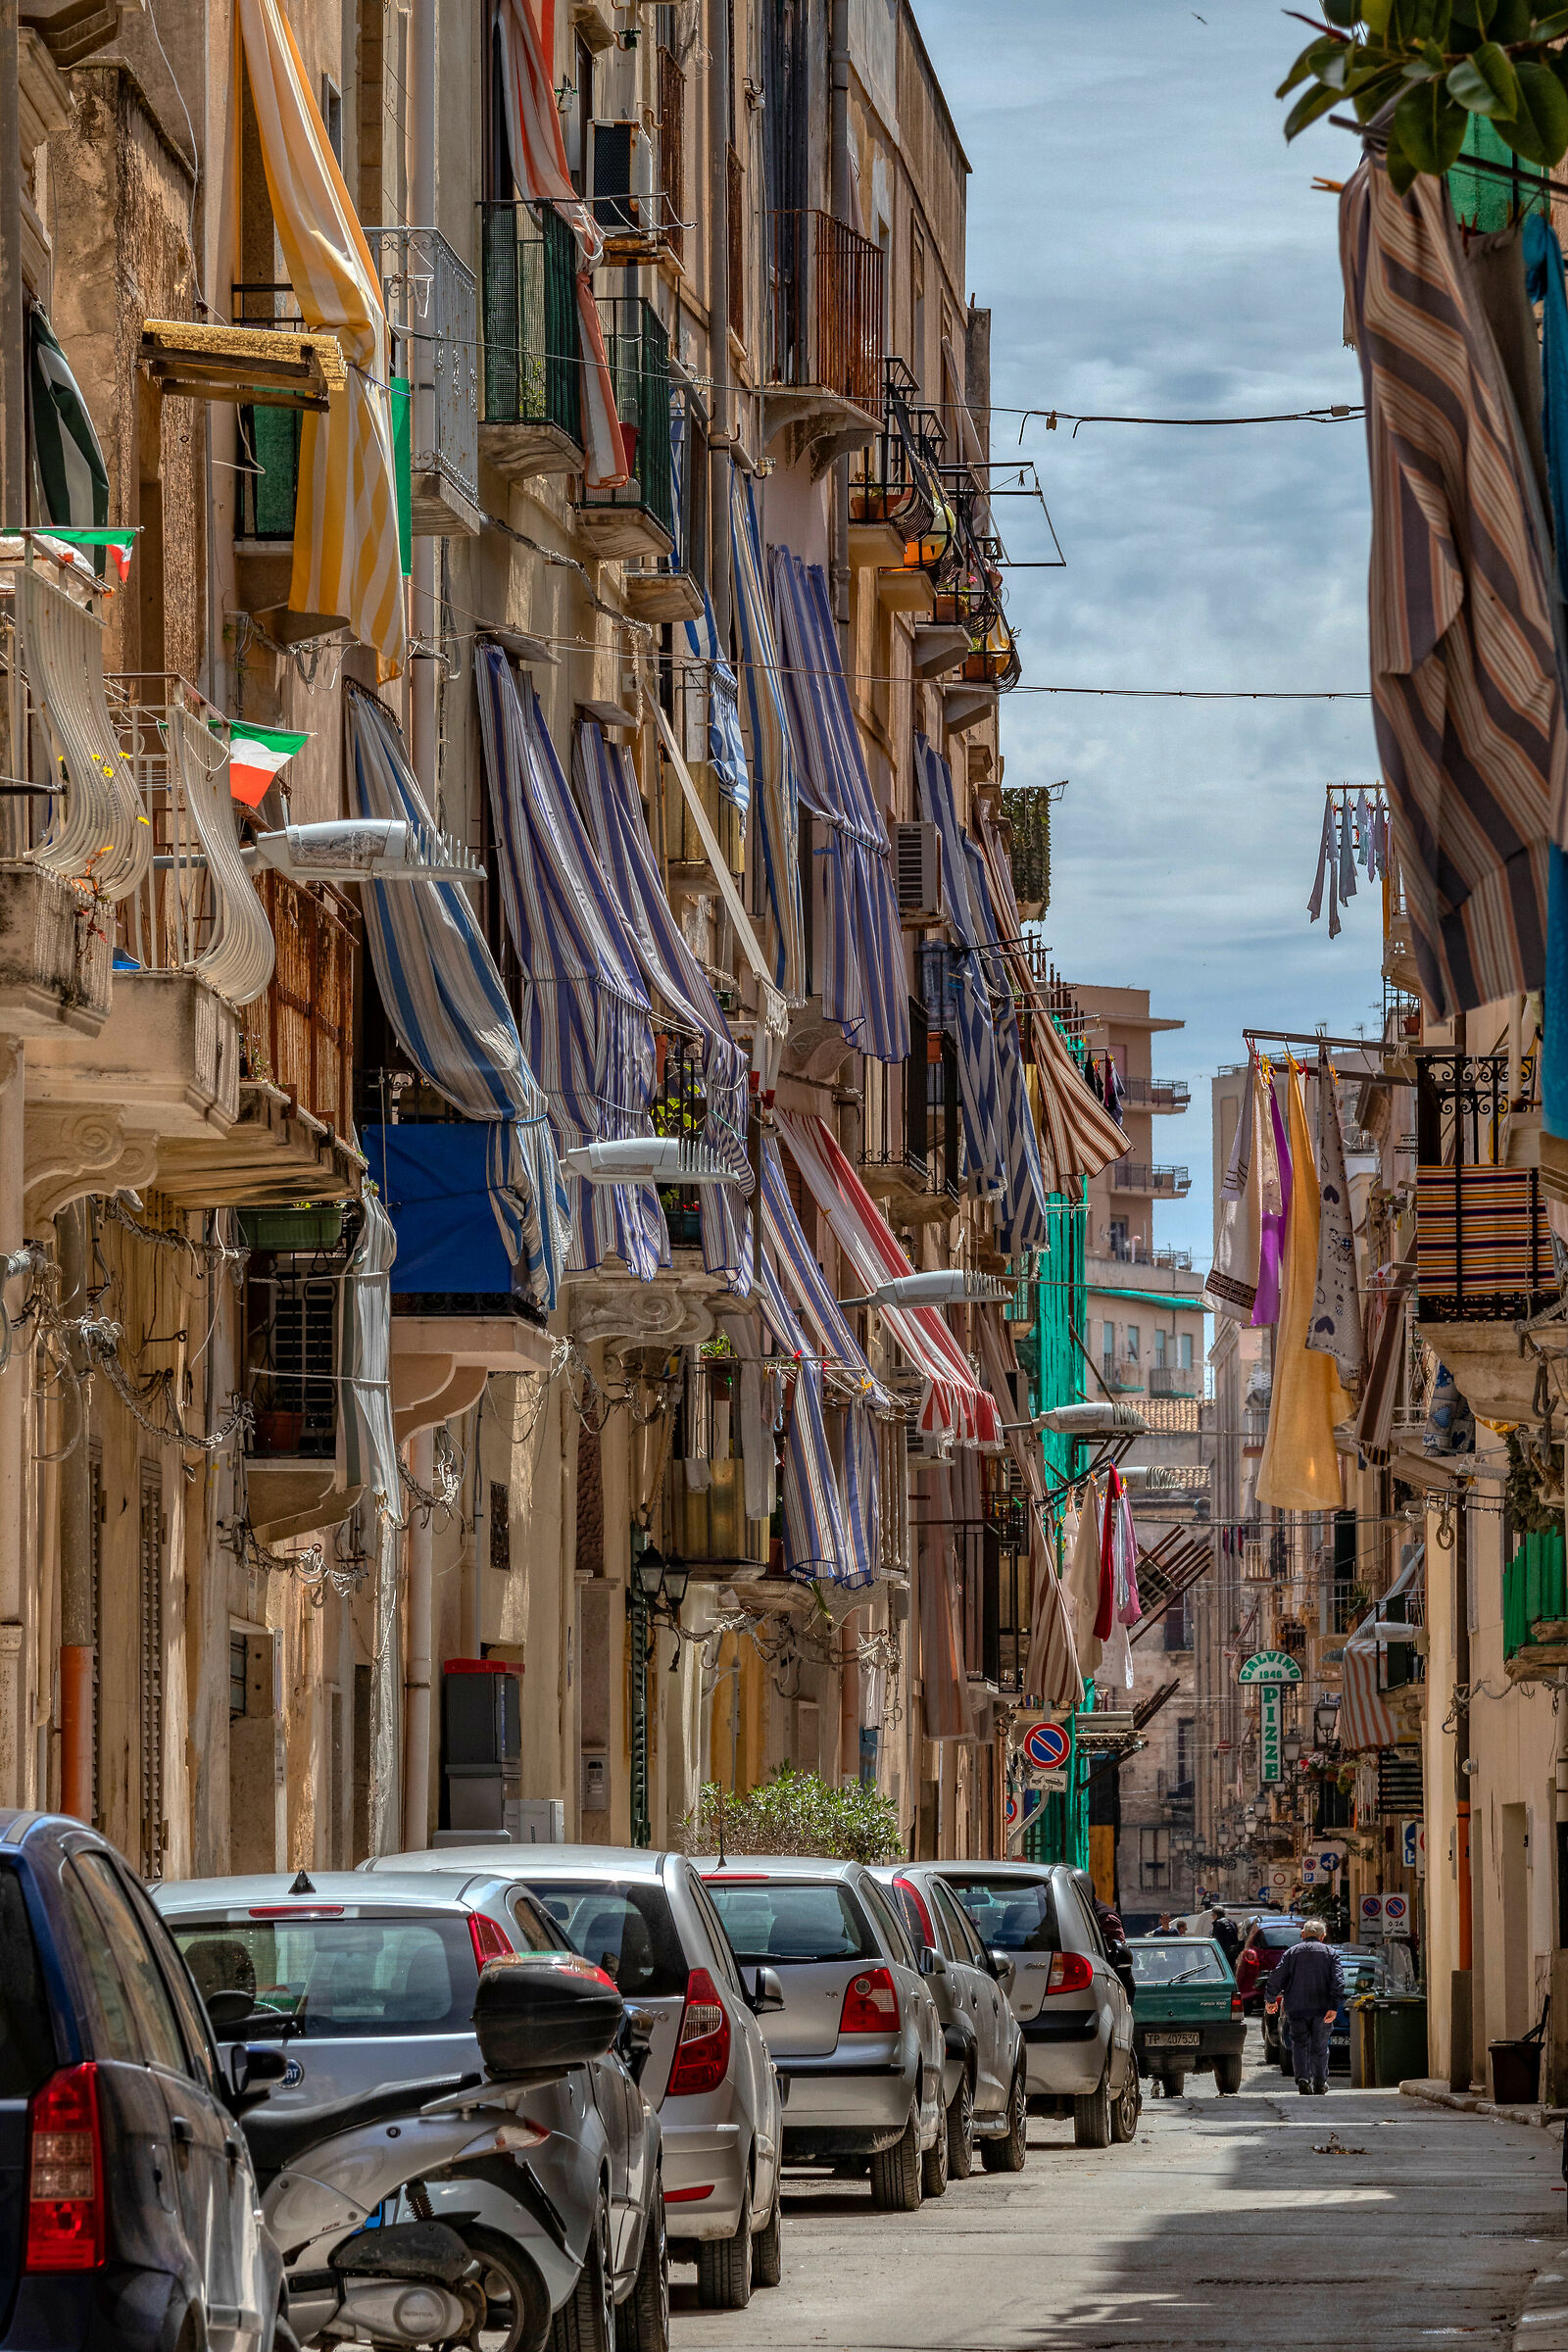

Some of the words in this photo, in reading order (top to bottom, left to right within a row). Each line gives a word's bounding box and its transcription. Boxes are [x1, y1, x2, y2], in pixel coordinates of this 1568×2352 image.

[1241, 1652, 1300, 1681] CALVINO
[1262, 1687, 1279, 1780] PIZZE
[1147, 2034, 1160, 2044] TP
